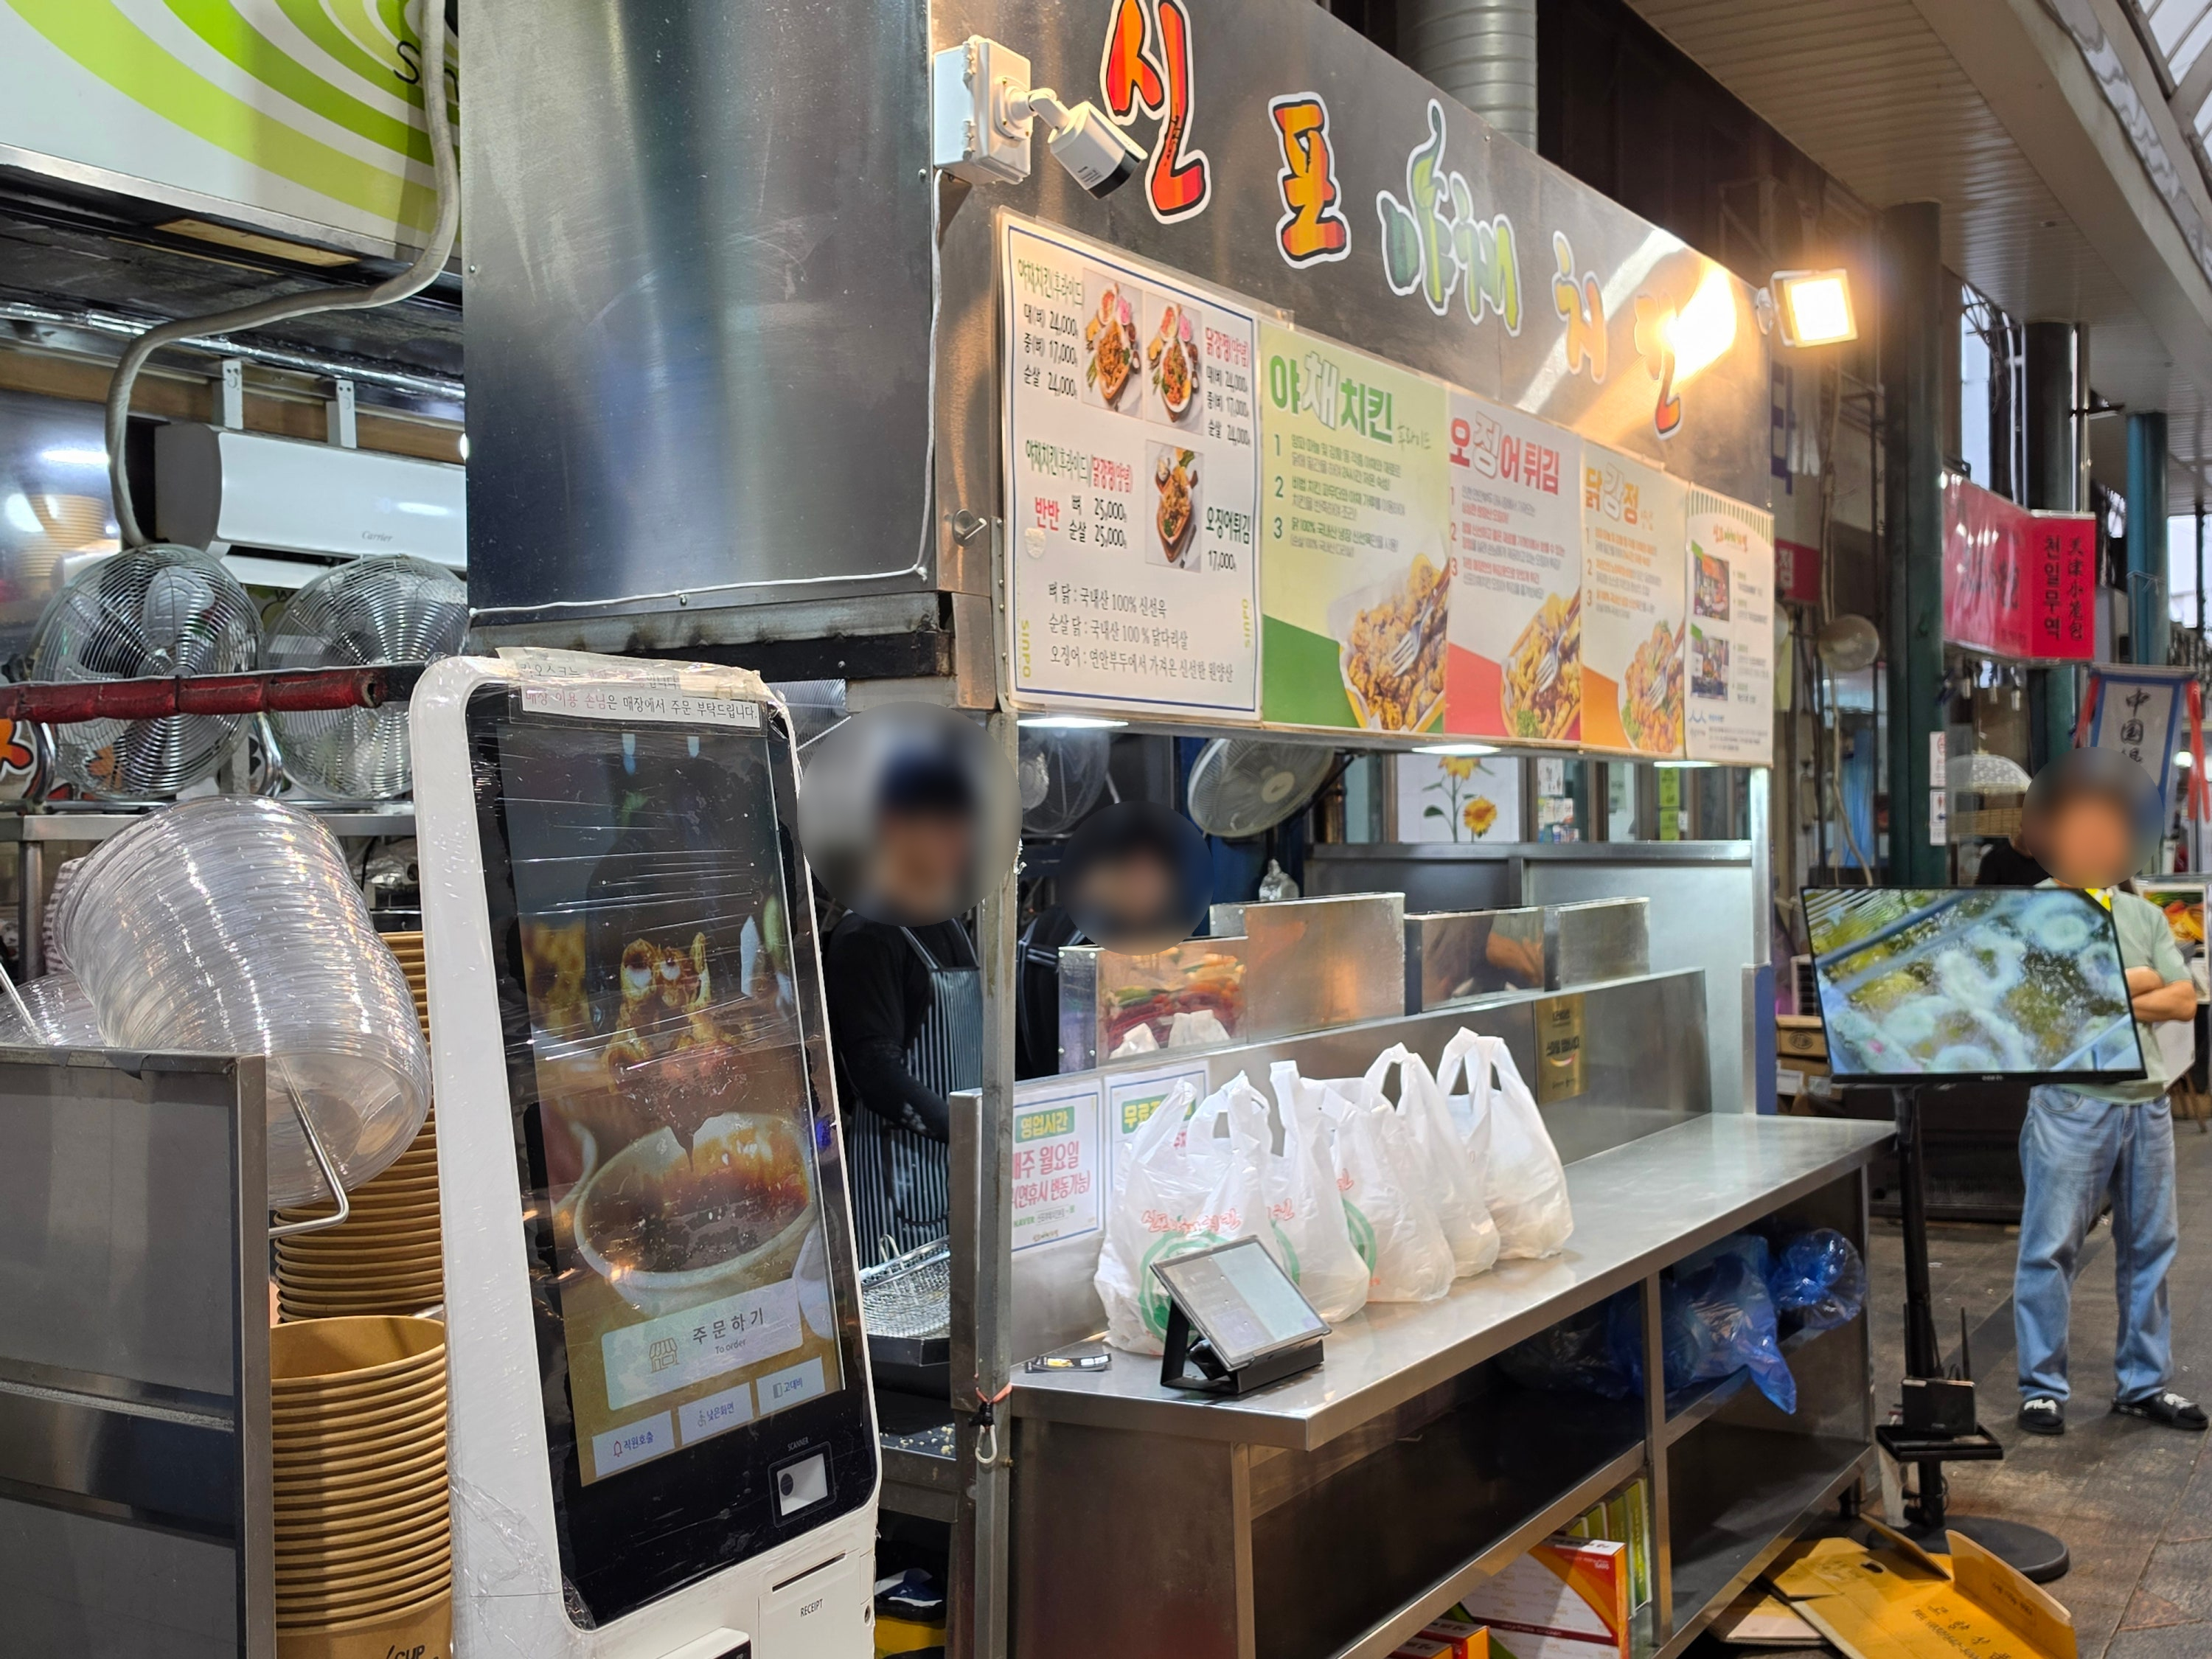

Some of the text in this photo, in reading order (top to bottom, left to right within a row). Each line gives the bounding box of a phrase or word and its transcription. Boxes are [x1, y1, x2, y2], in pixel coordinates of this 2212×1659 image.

[1023, 364, 1040, 388] 순살
[1269, 350, 1394, 445] 야채치킨
[1274, 476, 1284, 498] 2
[1585, 462, 1639, 526] 닭강정
[1034, 496, 1060, 532] 반반
[1206, 506, 1251, 545] 오징어튀김
[361, 530, 393, 543] Carrier
[1068, 519, 1086, 543] 순살
[1273, 517, 1283, 540] 3
[1079, 587, 1109, 610] 국내산
[1112, 594, 1137, 613] 100%
[1048, 613, 1069, 636] 순살
[1090, 619, 1119, 642] 국내산
[1050, 644, 1081, 668] 오징어
[1089, 649, 1147, 675] 연안부두에서
[1149, 655, 1178, 678] 가져온
[1180, 658, 1206, 680] 신선한
[555, 688, 578, 709] 이용
[585, 692, 618, 711] 손님은
[623, 696, 666, 714] 매장에서
[671, 700, 692, 716] 주문
[697, 701, 758, 720] 부탁드립니다.
[1020, 1110, 1068, 1139] 영업시간
[1039, 1141, 1079, 1176] 월요일
[1051, 1170, 1091, 1202] 변동가능)
[714, 1338, 747, 1354] To order
[783, 1377, 803, 1393] 고대비
[706, 1402, 734, 1422] 낮은화면
[623, 1430, 654, 1451] 직원호출
[787, 1436, 810, 1452] SCANNER
[800, 1597, 824, 1618] RECEIPT
